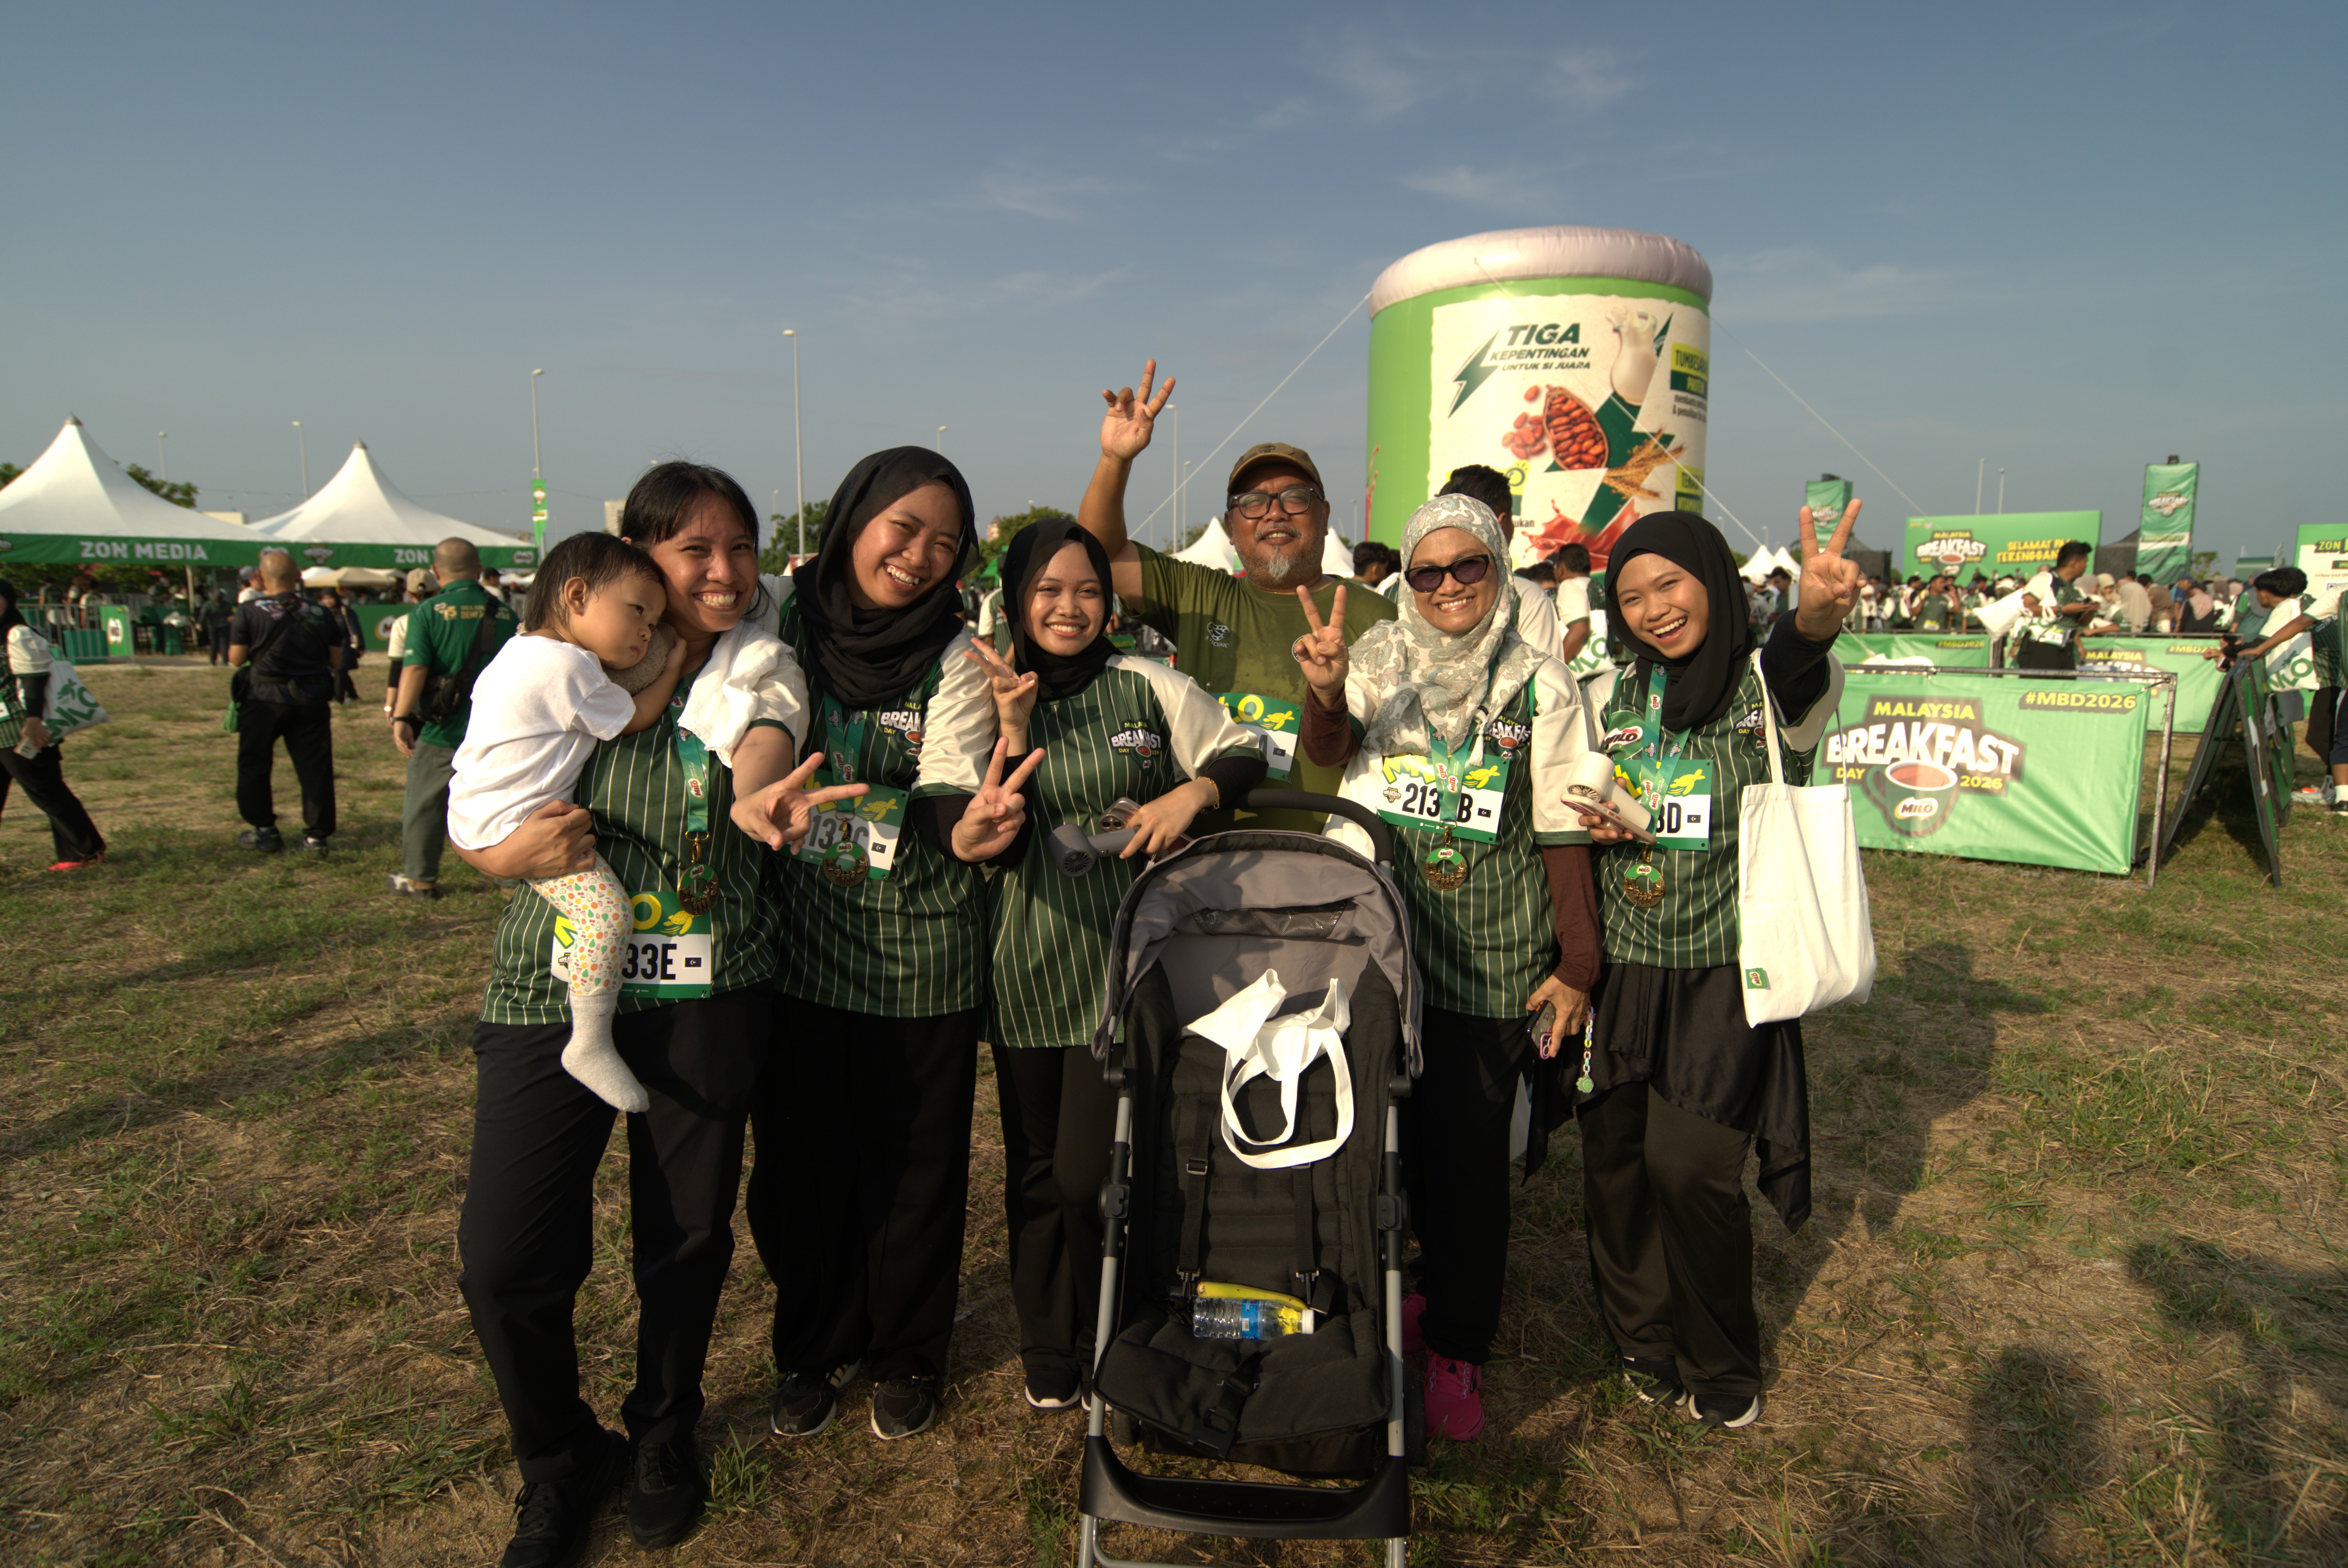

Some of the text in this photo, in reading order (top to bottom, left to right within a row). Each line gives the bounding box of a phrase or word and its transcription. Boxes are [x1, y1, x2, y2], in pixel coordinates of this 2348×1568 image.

[1507, 323, 1580, 346] TIGA
[1490, 347, 1590, 361] KEPENTINGAN
[1514, 518, 1535, 528] ukan
[80, 541, 208, 561] ZON MEDIA
[1917, 539, 1986, 557] BREAKFAST
[2008, 539, 2052, 550] SELAMAT
[2318, 540, 2341, 551] ZON
[394, 549, 429, 563] ZON
[1996, 549, 2058, 563] TERENGGAN
[2086, 652, 2142, 660] MALAYSIA
[904, 701, 921, 710] MALA
[2025, 691, 2137, 709] #MBD2026
[1873, 702, 1975, 720] MALAYSIA
[1826, 722, 2019, 774] BREAKFAST
[1836, 767, 1866, 779] DAY
[693, 780, 702, 796] MILO
[1960, 775, 2003, 789] 2026
[1402, 783, 1473, 823] 213B
[1901, 804, 1933, 813] MILO
[692, 867, 703, 876] MILO
